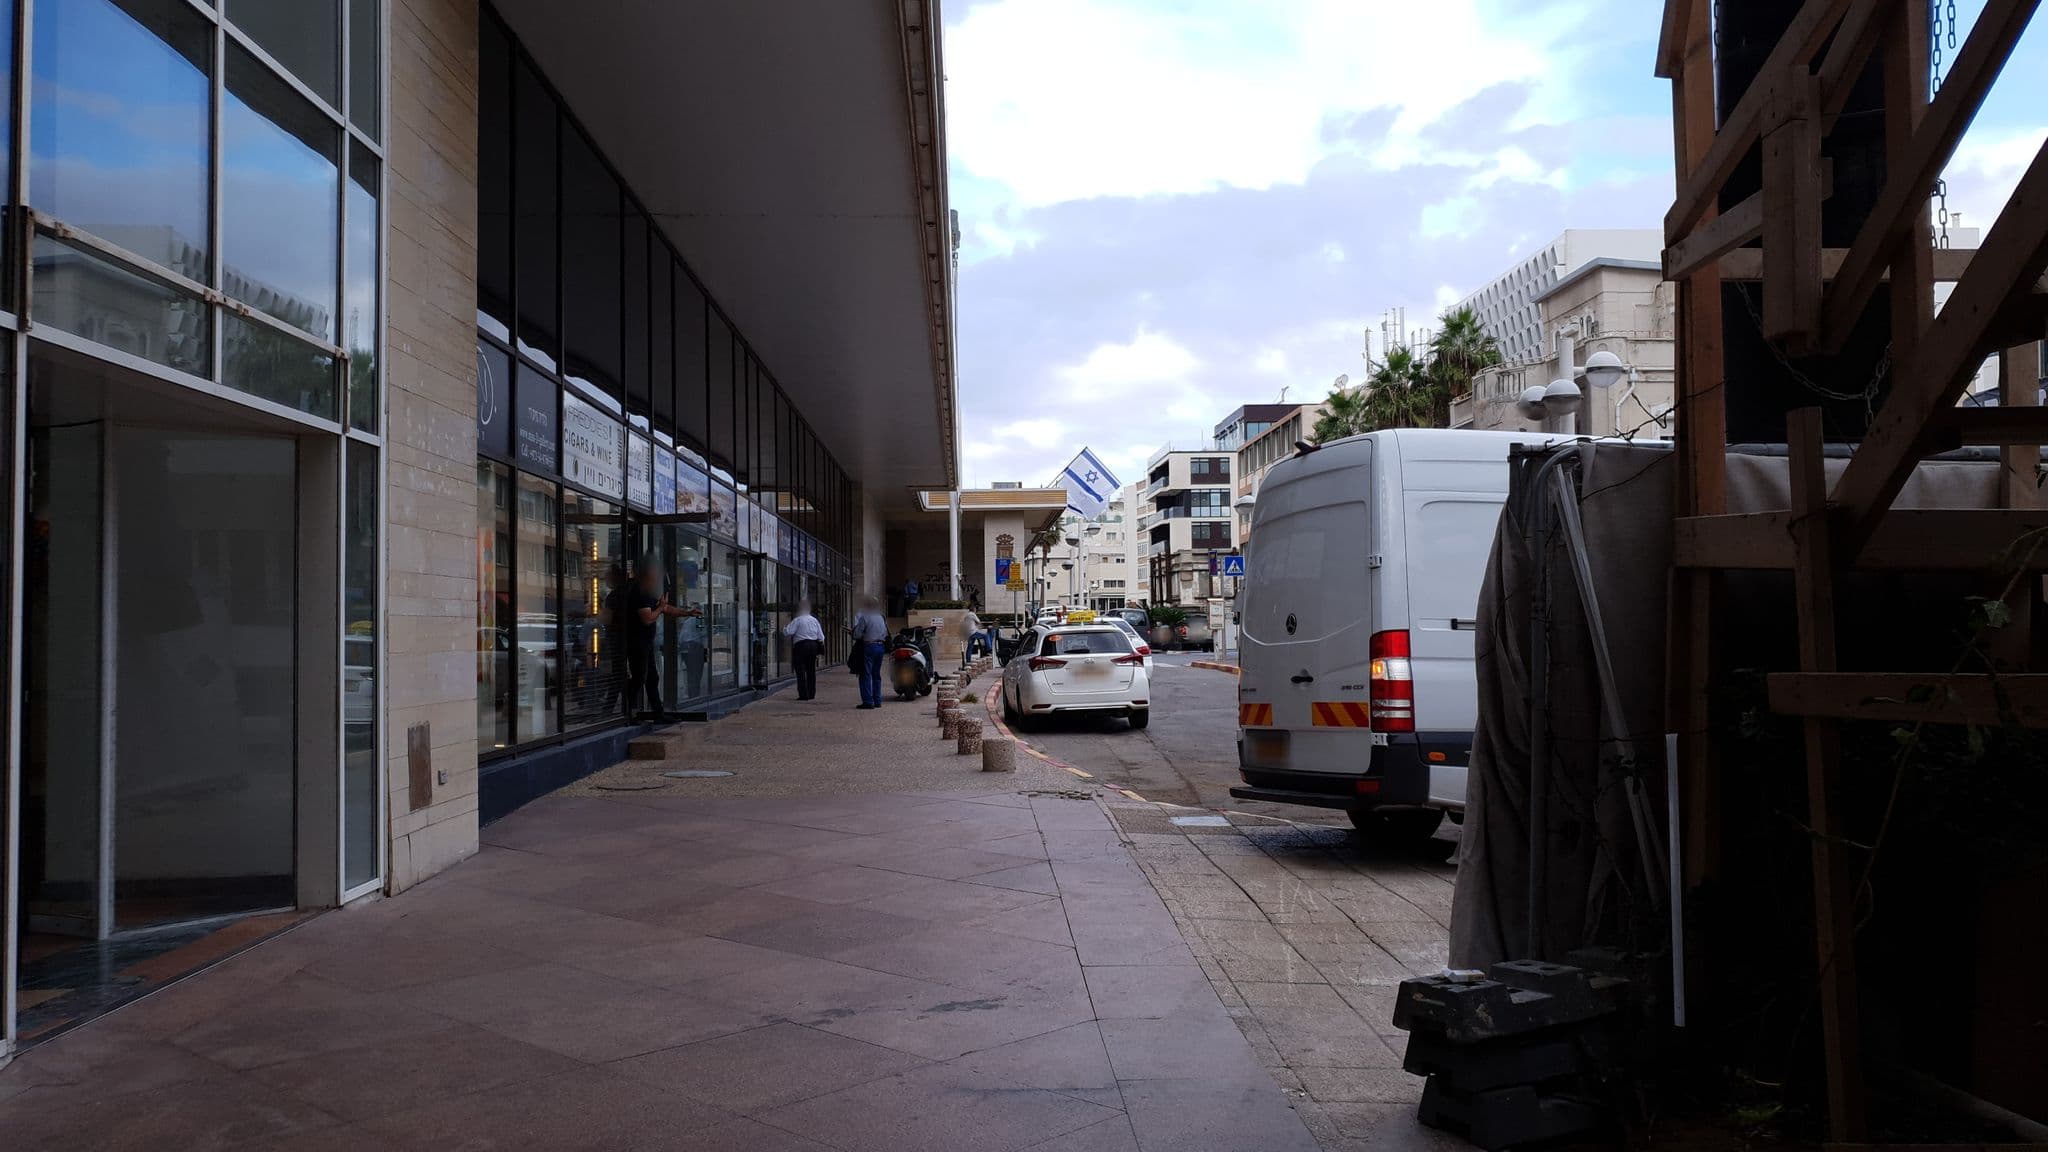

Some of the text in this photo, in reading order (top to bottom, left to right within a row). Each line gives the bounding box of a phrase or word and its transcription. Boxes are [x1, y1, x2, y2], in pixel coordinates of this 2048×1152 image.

[564, 428, 589, 454] CIGARS
[590, 442, 596, 457] &
[597, 445, 612, 465] WINE
